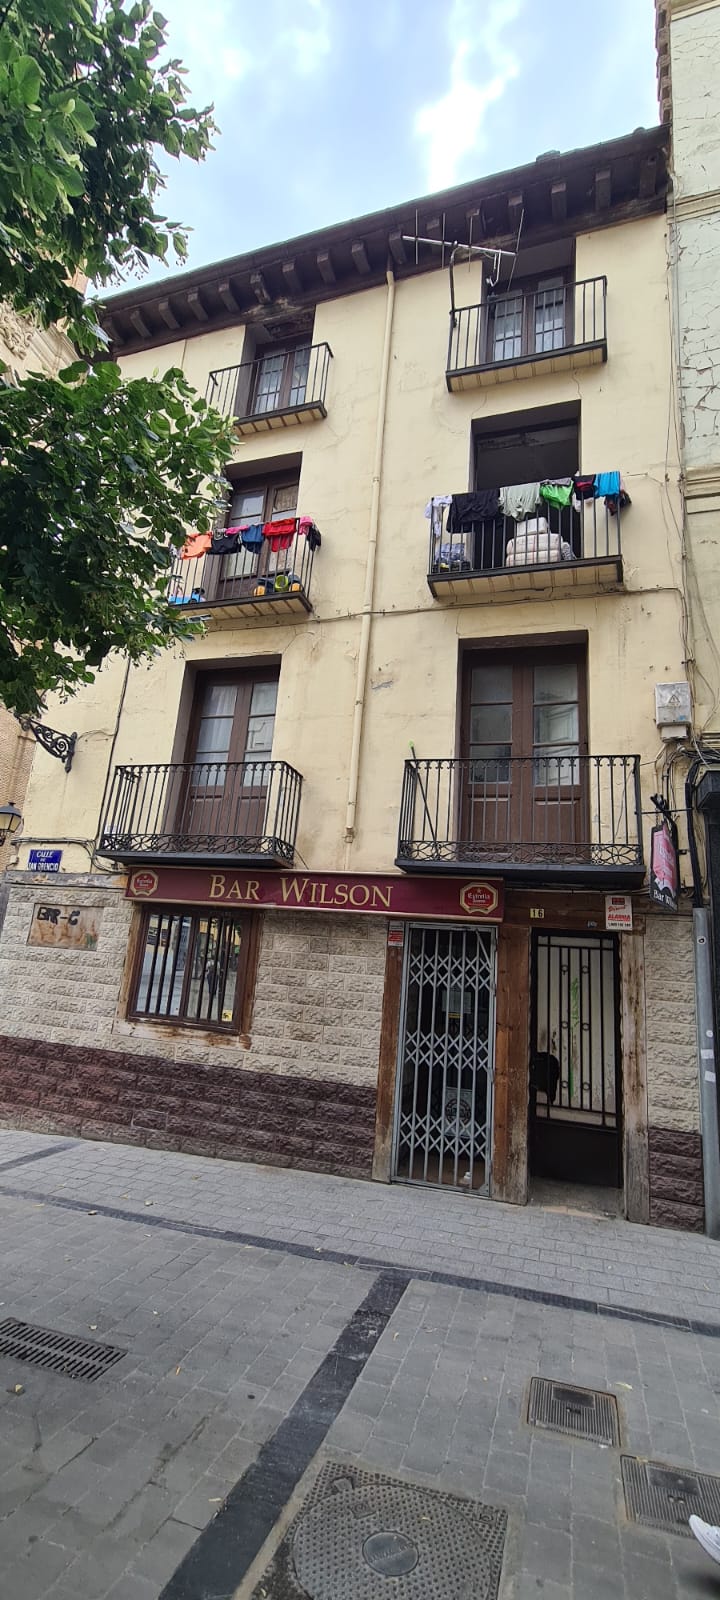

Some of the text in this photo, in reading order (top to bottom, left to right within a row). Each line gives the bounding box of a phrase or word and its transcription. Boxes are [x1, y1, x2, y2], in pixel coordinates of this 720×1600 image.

[36, 850, 54, 858] CALLE
[38, 862, 59, 871] ORENCIO
[208, 874, 394, 908] BAR WILSON
[653, 889, 665, 902] Bar
[467, 892, 490, 900] Estrella
[532, 909, 543, 918] 16
